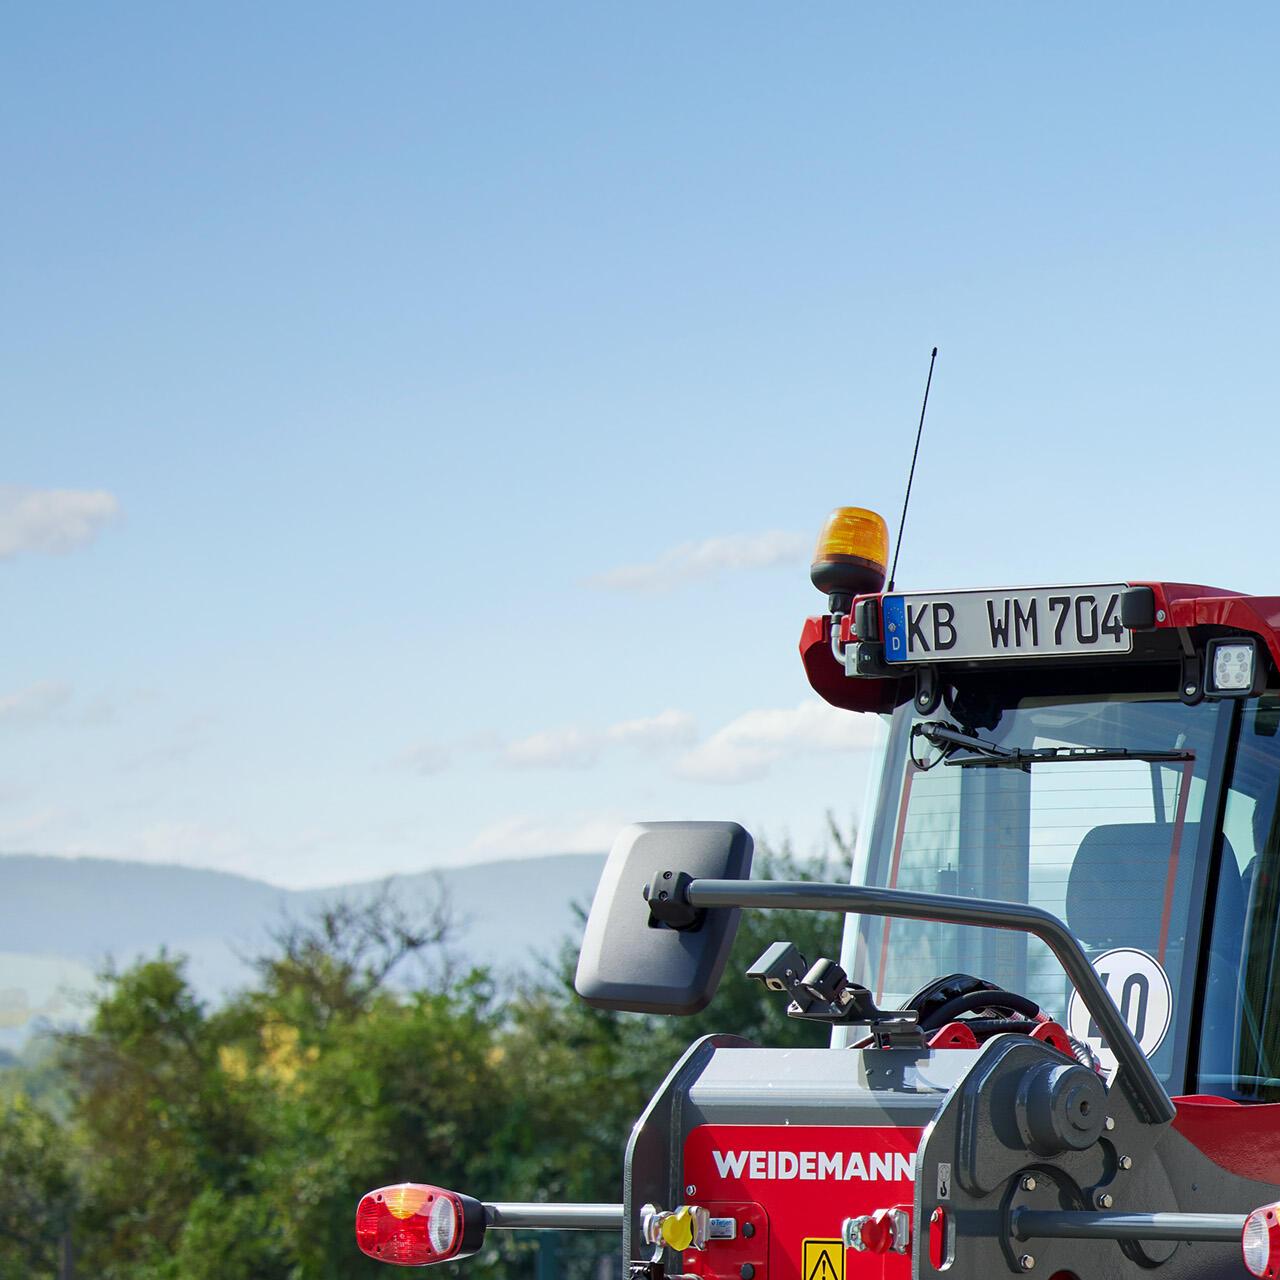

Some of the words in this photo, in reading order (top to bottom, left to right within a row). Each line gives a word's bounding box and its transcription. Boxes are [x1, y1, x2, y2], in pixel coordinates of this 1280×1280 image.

[907, 602, 957, 652] KB
[987, 598, 1038, 648] WM
[1049, 594, 1124, 646] 704
[892, 636, 900, 650] D
[712, 1150, 917, 1181] WEIDEMANN
